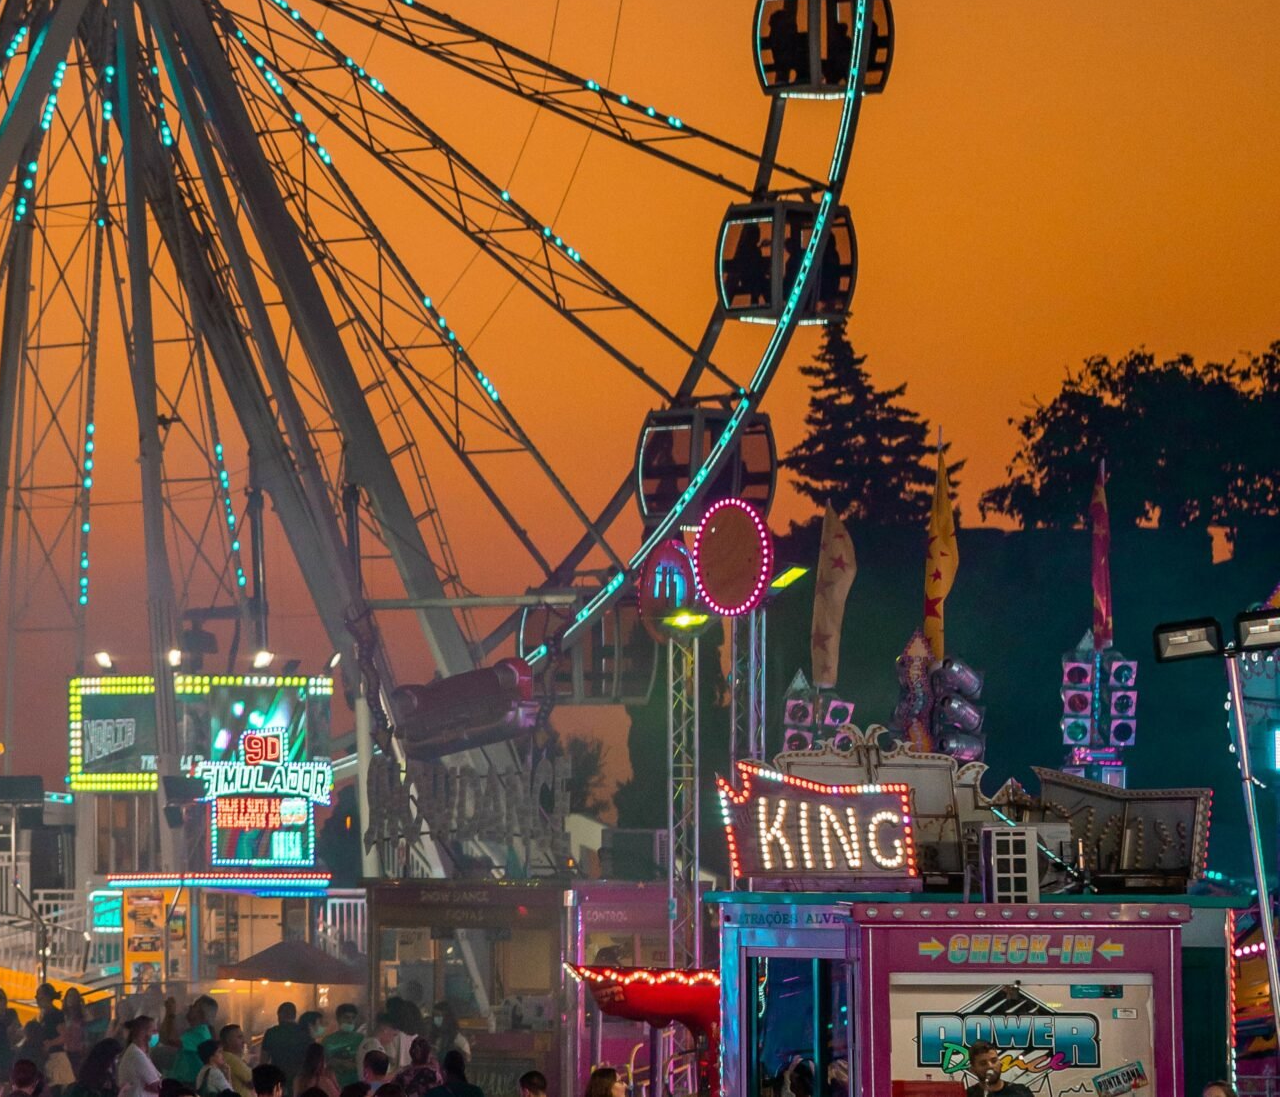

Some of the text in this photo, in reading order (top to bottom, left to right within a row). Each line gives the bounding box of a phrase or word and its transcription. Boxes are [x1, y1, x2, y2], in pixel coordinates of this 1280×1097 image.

[245, 734, 280, 765] 9D
[202, 766, 331, 799] SIMULADOR
[757, 796, 904, 871] KING
[744, 910, 798, 925] TRAÇÕES
[947, 934, 1096, 965] CHECK-IN
[919, 1014, 1099, 1066] POWER
[942, 1042, 1072, 1074] Dnce
[1097, 1066, 1140, 1091] PUNTA CANA
